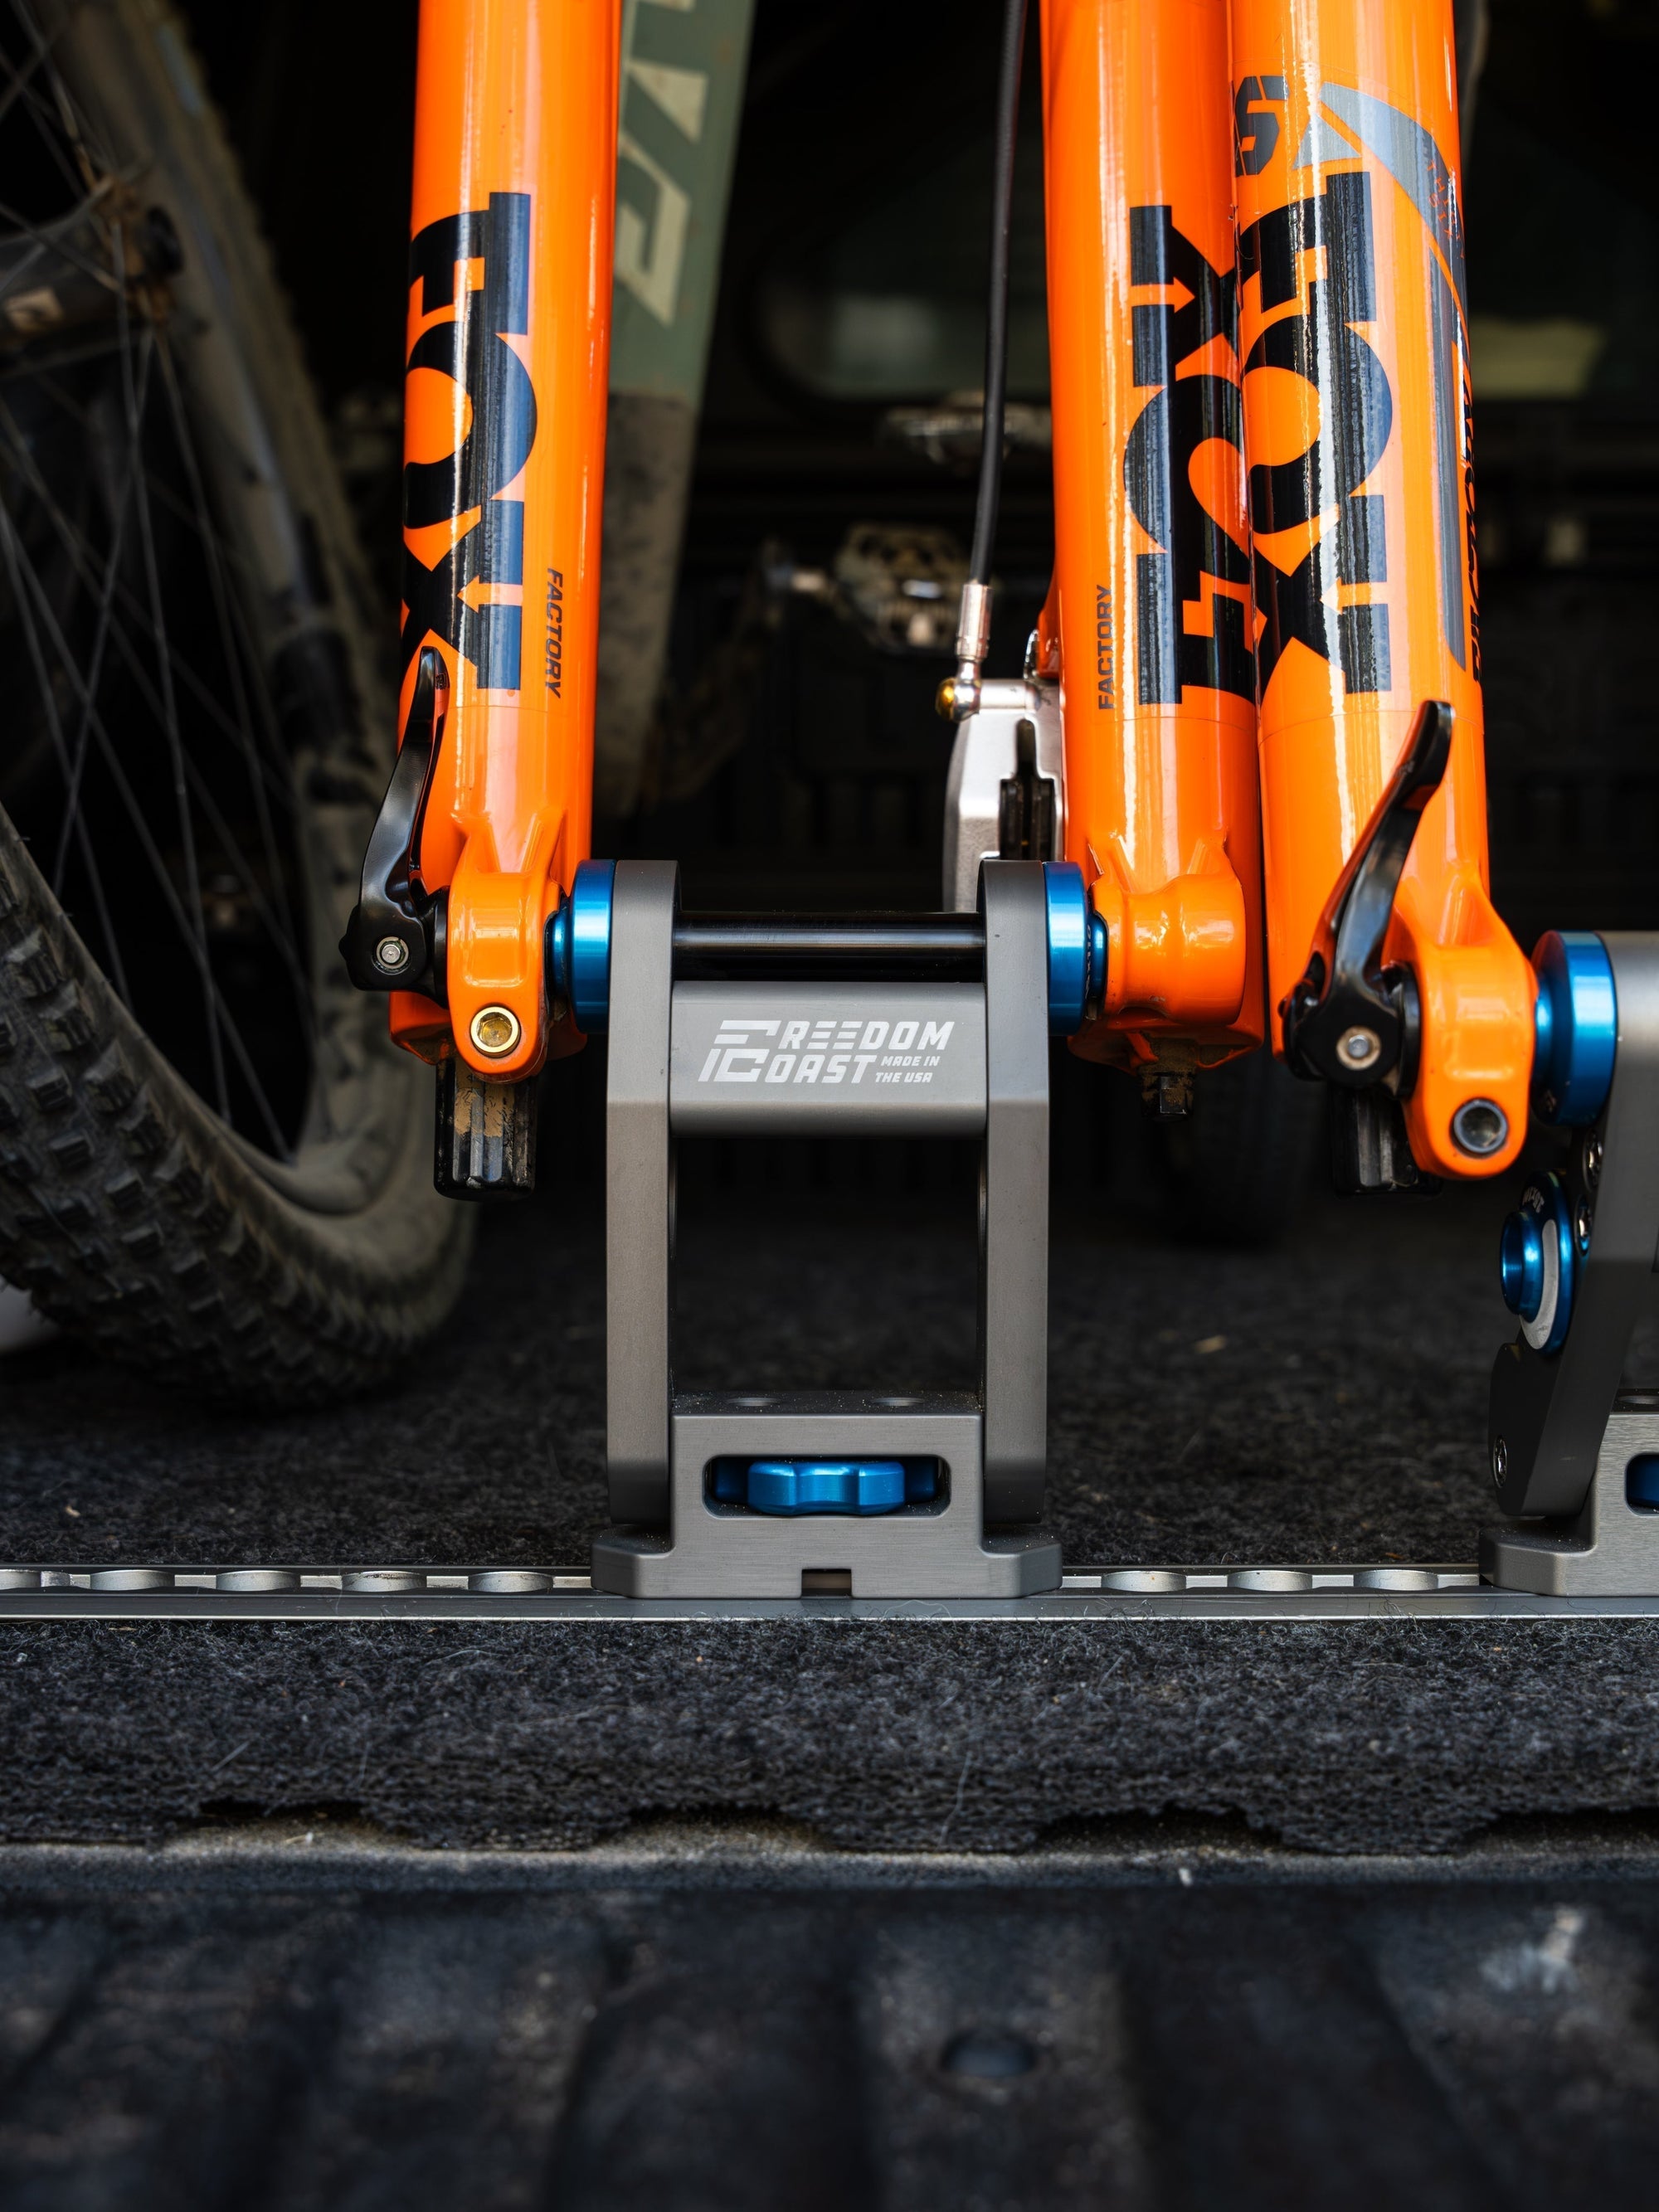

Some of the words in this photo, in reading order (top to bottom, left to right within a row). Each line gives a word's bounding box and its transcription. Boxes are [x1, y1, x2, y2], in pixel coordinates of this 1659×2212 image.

[401, 192, 538, 690] FOX
[1124, 205, 1255, 705] FOX
[1236, 171, 1394, 695] FOX
[545, 567, 563, 699] FACTORY
[1097, 584, 1115, 710] FACTORY
[713, 1020, 955, 1051] FREEDOM
[713, 1048, 877, 1083] COAST
[875, 1072, 902, 1082] THE
[903, 1072, 933, 1082] USA
[880, 1055, 922, 1067] MADE
[922, 1055, 941, 1067] IN
